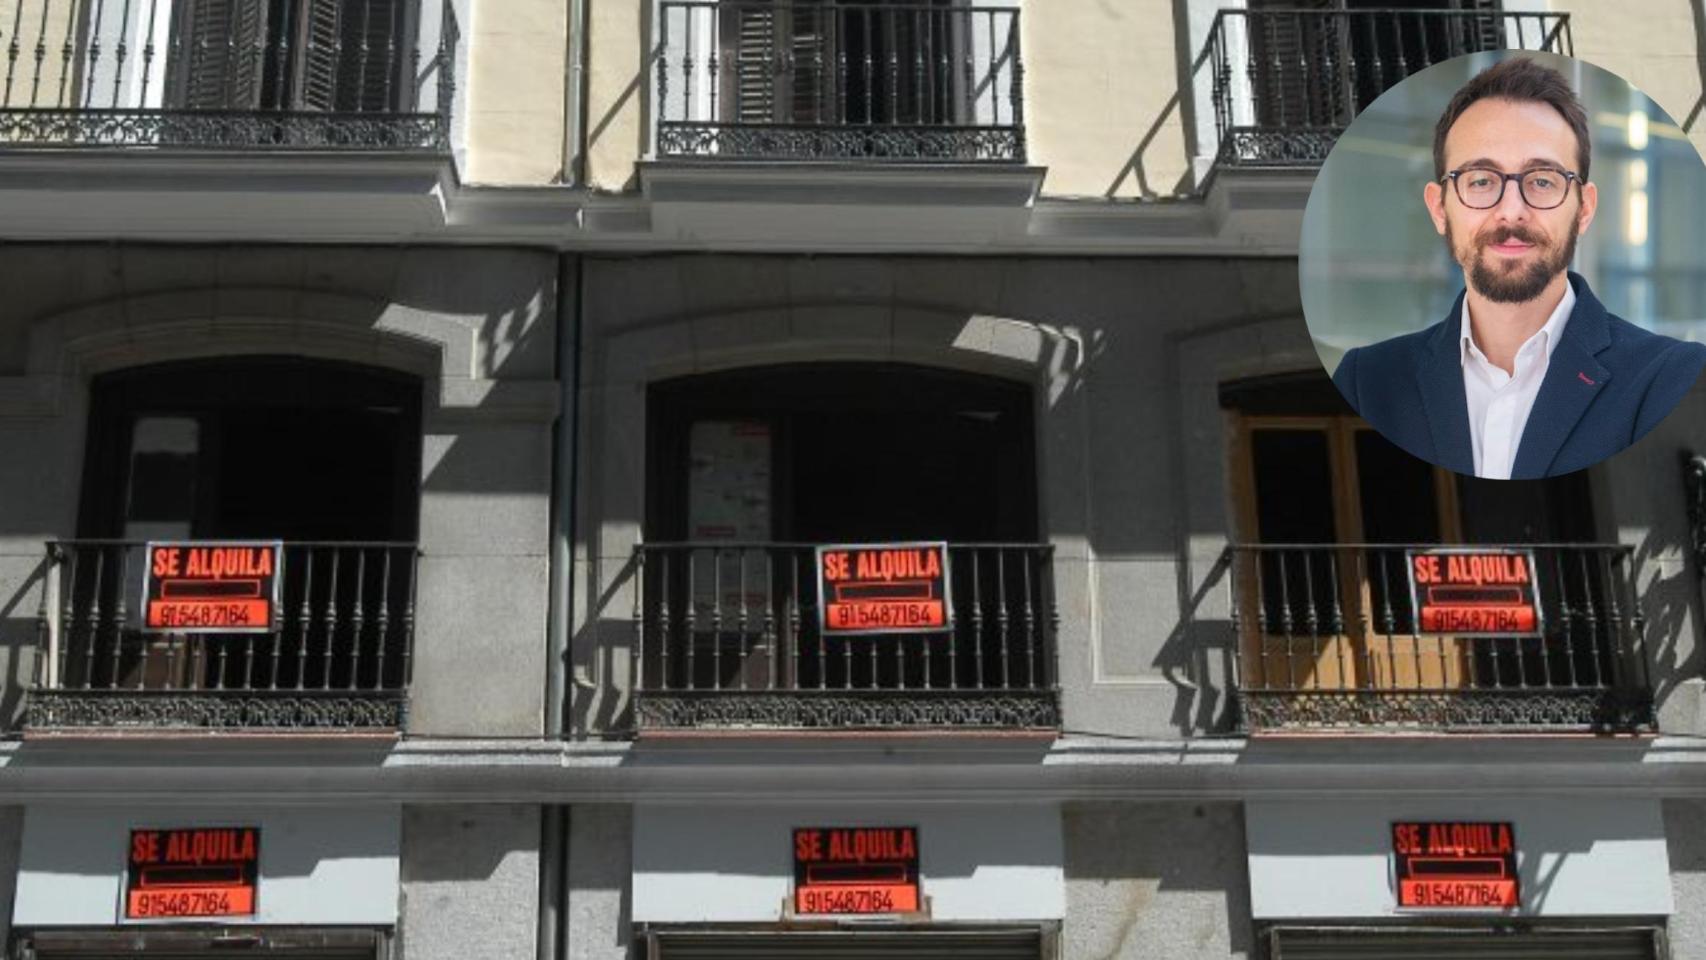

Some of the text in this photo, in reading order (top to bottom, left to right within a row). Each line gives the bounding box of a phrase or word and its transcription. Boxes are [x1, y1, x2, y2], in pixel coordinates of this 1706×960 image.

[153, 547, 271, 580] SE ALQUILA
[824, 549, 940, 581] SE ALQUILA
[1414, 555, 1528, 585] SE ALQUILA
[160, 604, 251, 625] 915487164
[837, 604, 932, 625] 915487164
[1433, 610, 1519, 631] 915487164
[133, 829, 256, 865] SE ALQUILA
[796, 829, 915, 864] SE ALQUILA
[1395, 824, 1511, 857] SE ALQUILA
[137, 892, 231, 915] 915487164
[804, 890, 894, 913] 915487164
[1413, 883, 1503, 906] 915487164
